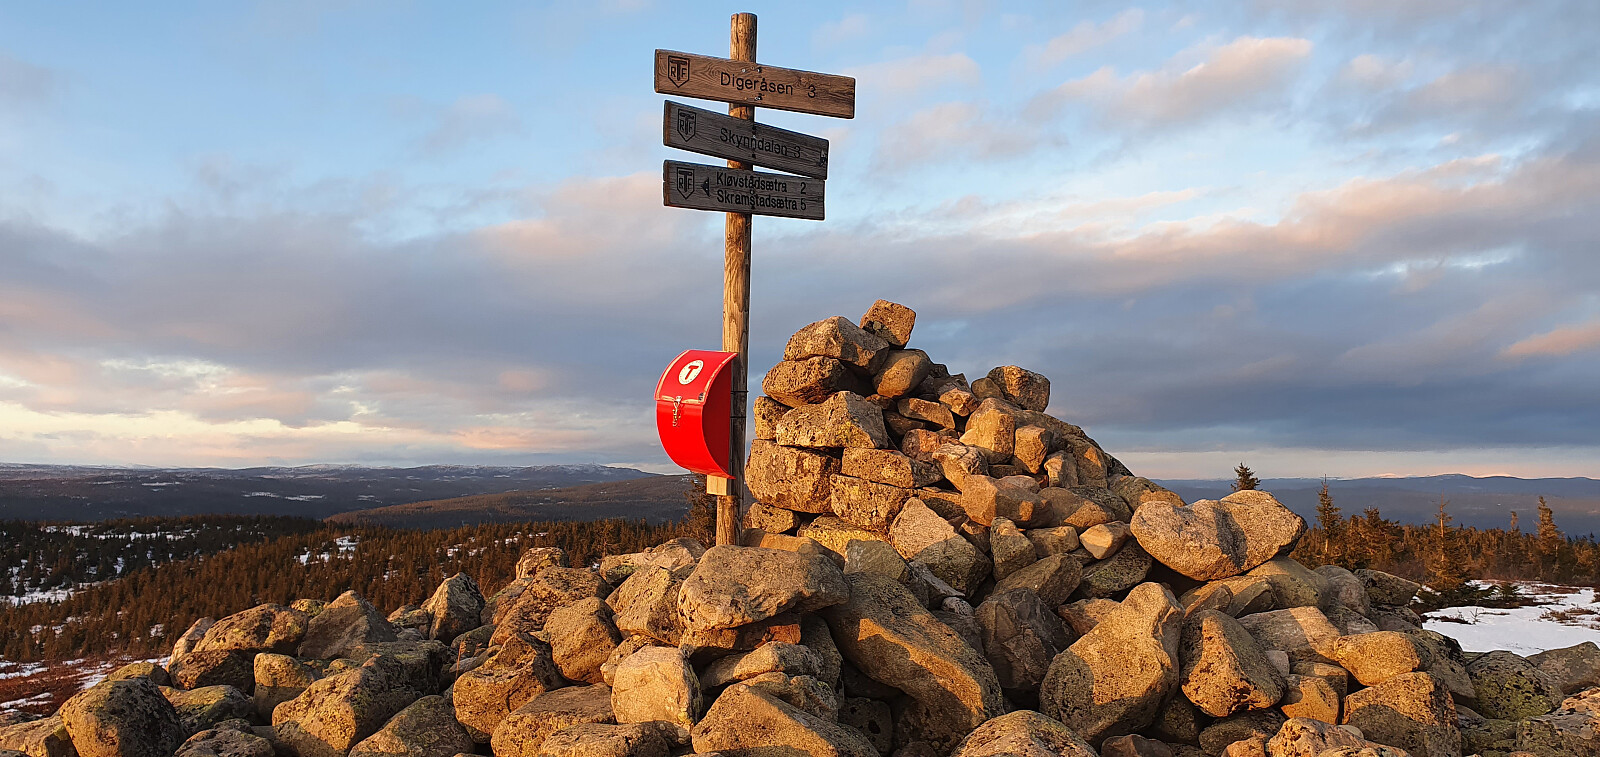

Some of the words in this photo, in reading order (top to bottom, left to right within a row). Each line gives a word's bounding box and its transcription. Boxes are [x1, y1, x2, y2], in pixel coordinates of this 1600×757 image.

[720, 72, 794, 95] Digeråsen
[807, 84, 816, 98] 3
[719, 128, 788, 156] Skynndalen
[793, 146, 801, 158] 3
[800, 182, 807, 194] 2
[716, 190, 798, 211] Skramstadsætra
[800, 199, 807, 211] 5
[685, 365, 699, 380] T
